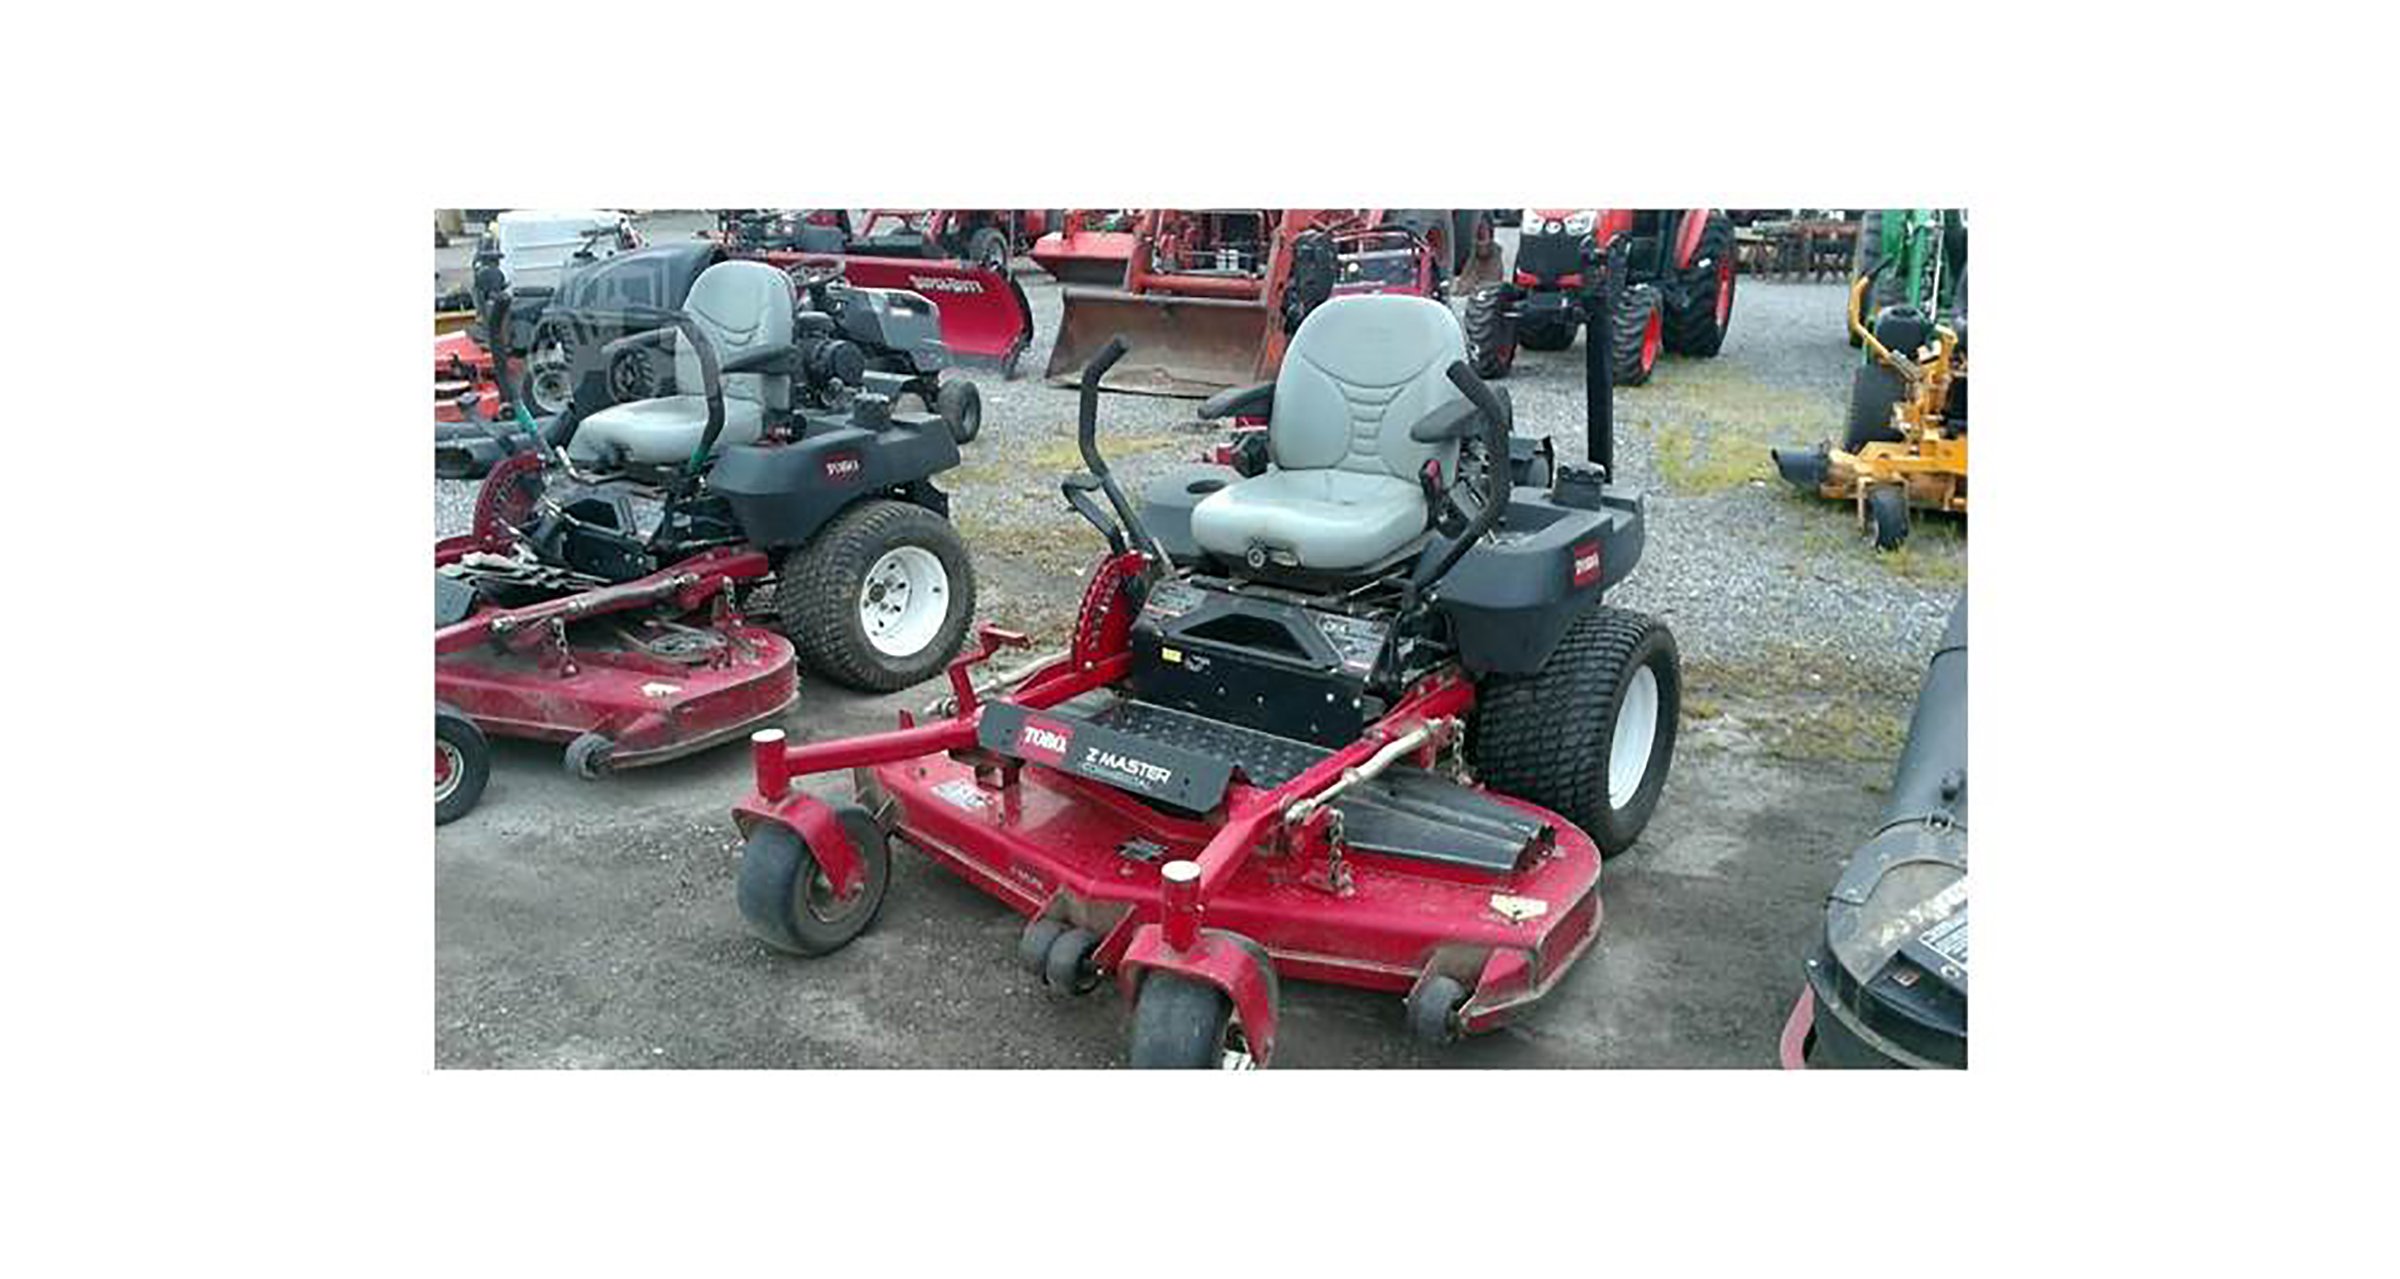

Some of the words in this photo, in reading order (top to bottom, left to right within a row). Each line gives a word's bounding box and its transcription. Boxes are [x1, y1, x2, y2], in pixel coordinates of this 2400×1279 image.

[1024, 726, 1067, 753] TORO
[1086, 748, 1100, 763] Z
[1101, 752, 1172, 784] MASTER
